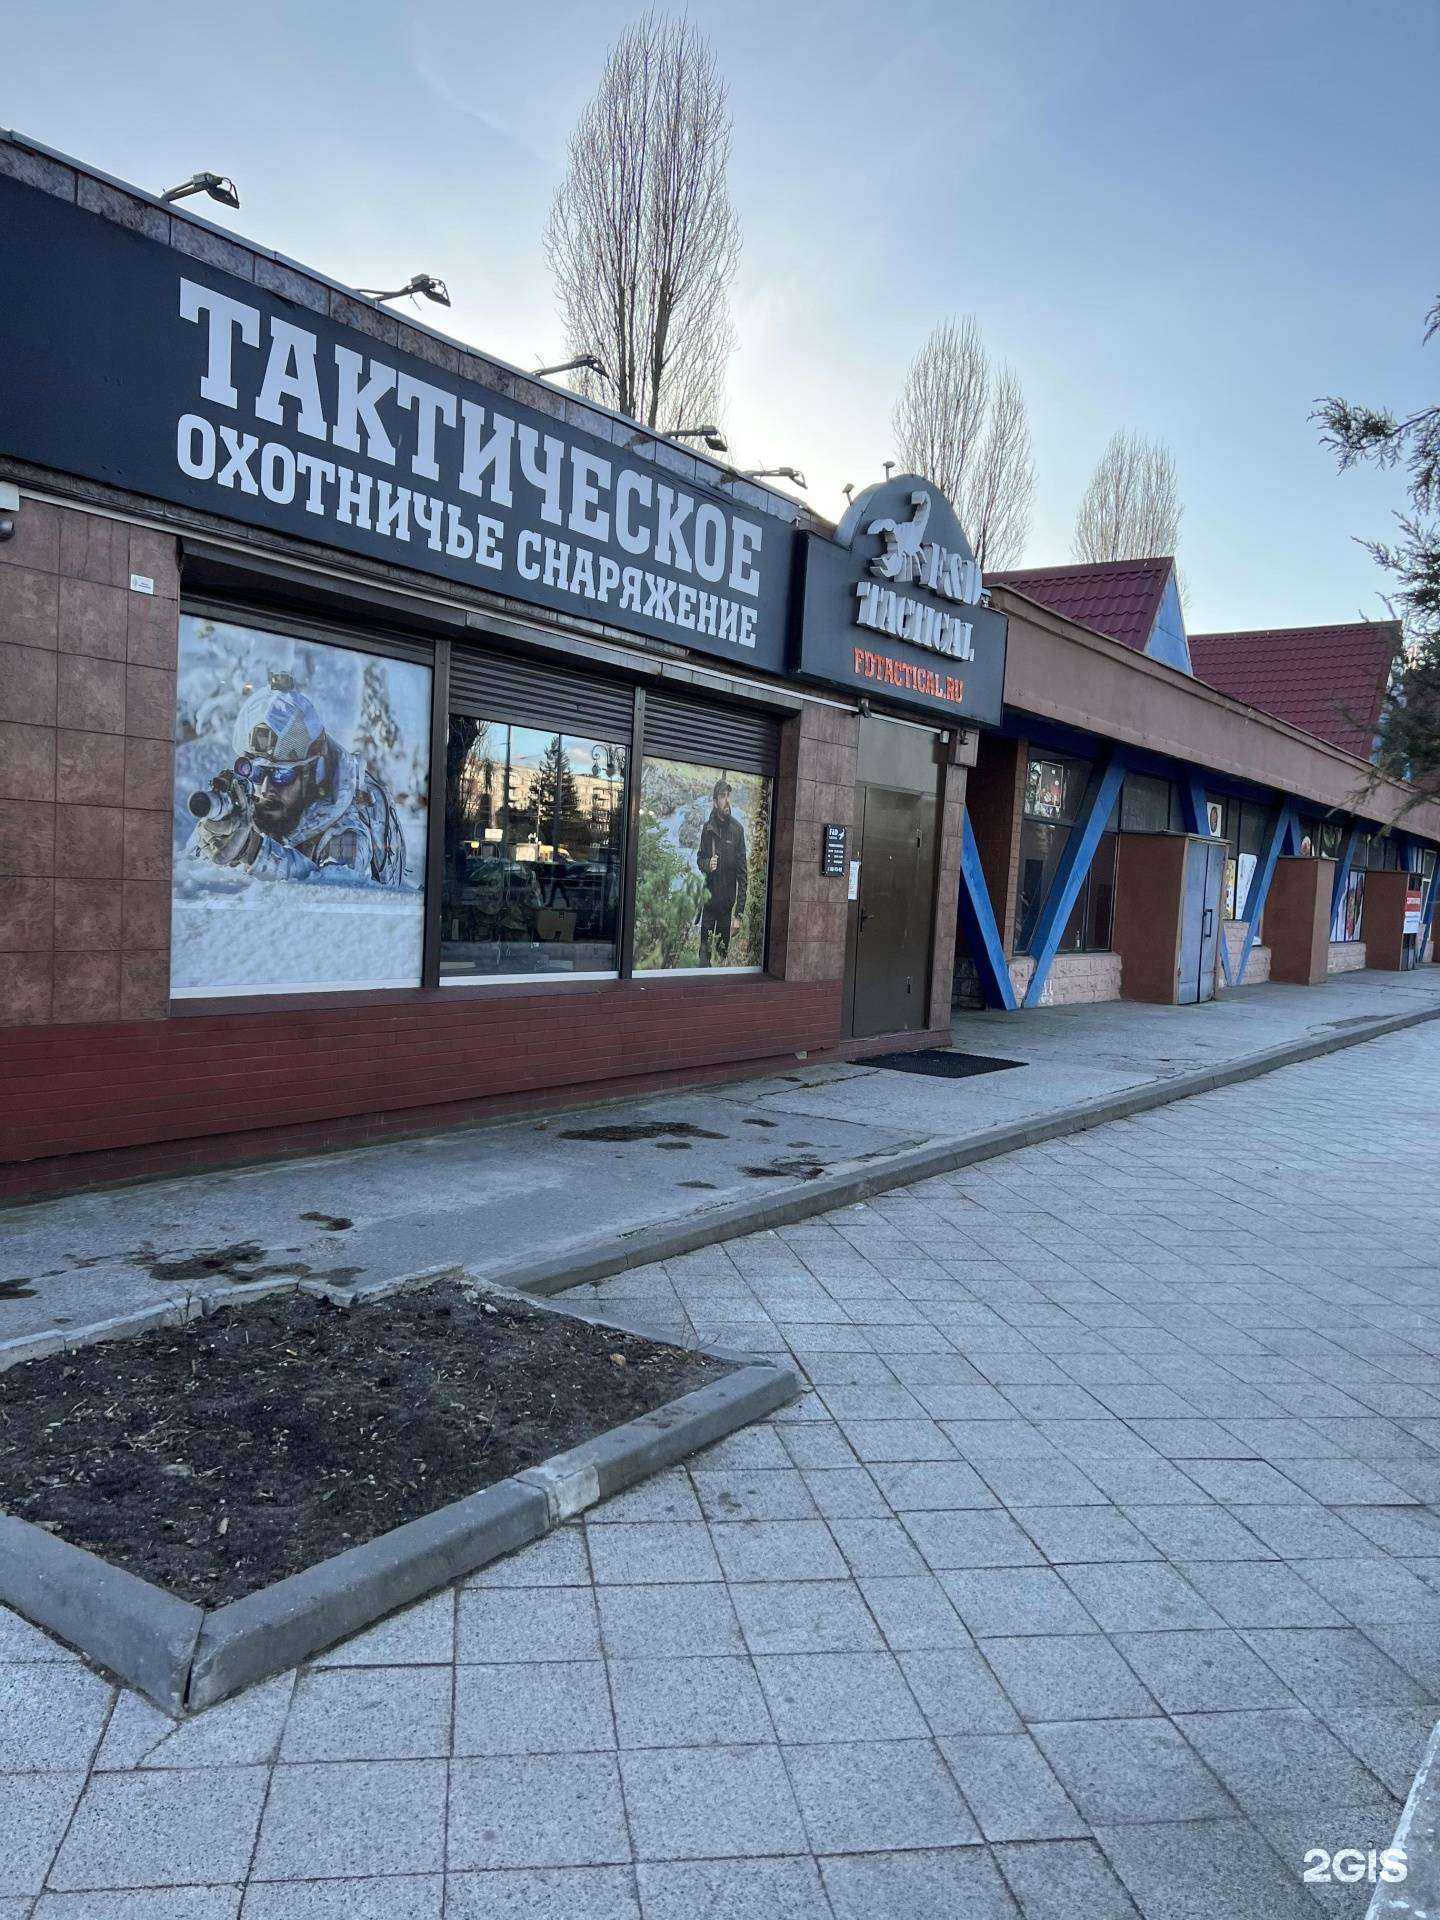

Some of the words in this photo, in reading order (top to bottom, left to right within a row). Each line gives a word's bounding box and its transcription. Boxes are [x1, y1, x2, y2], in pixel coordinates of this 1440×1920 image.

[177, 413, 504, 571] ОХОТНИЧЬЕ
[516, 529, 757, 648] СНАРЯЖЕНИЕ
[180, 278, 763, 597] ТАКТИЧЕСКОЕ
